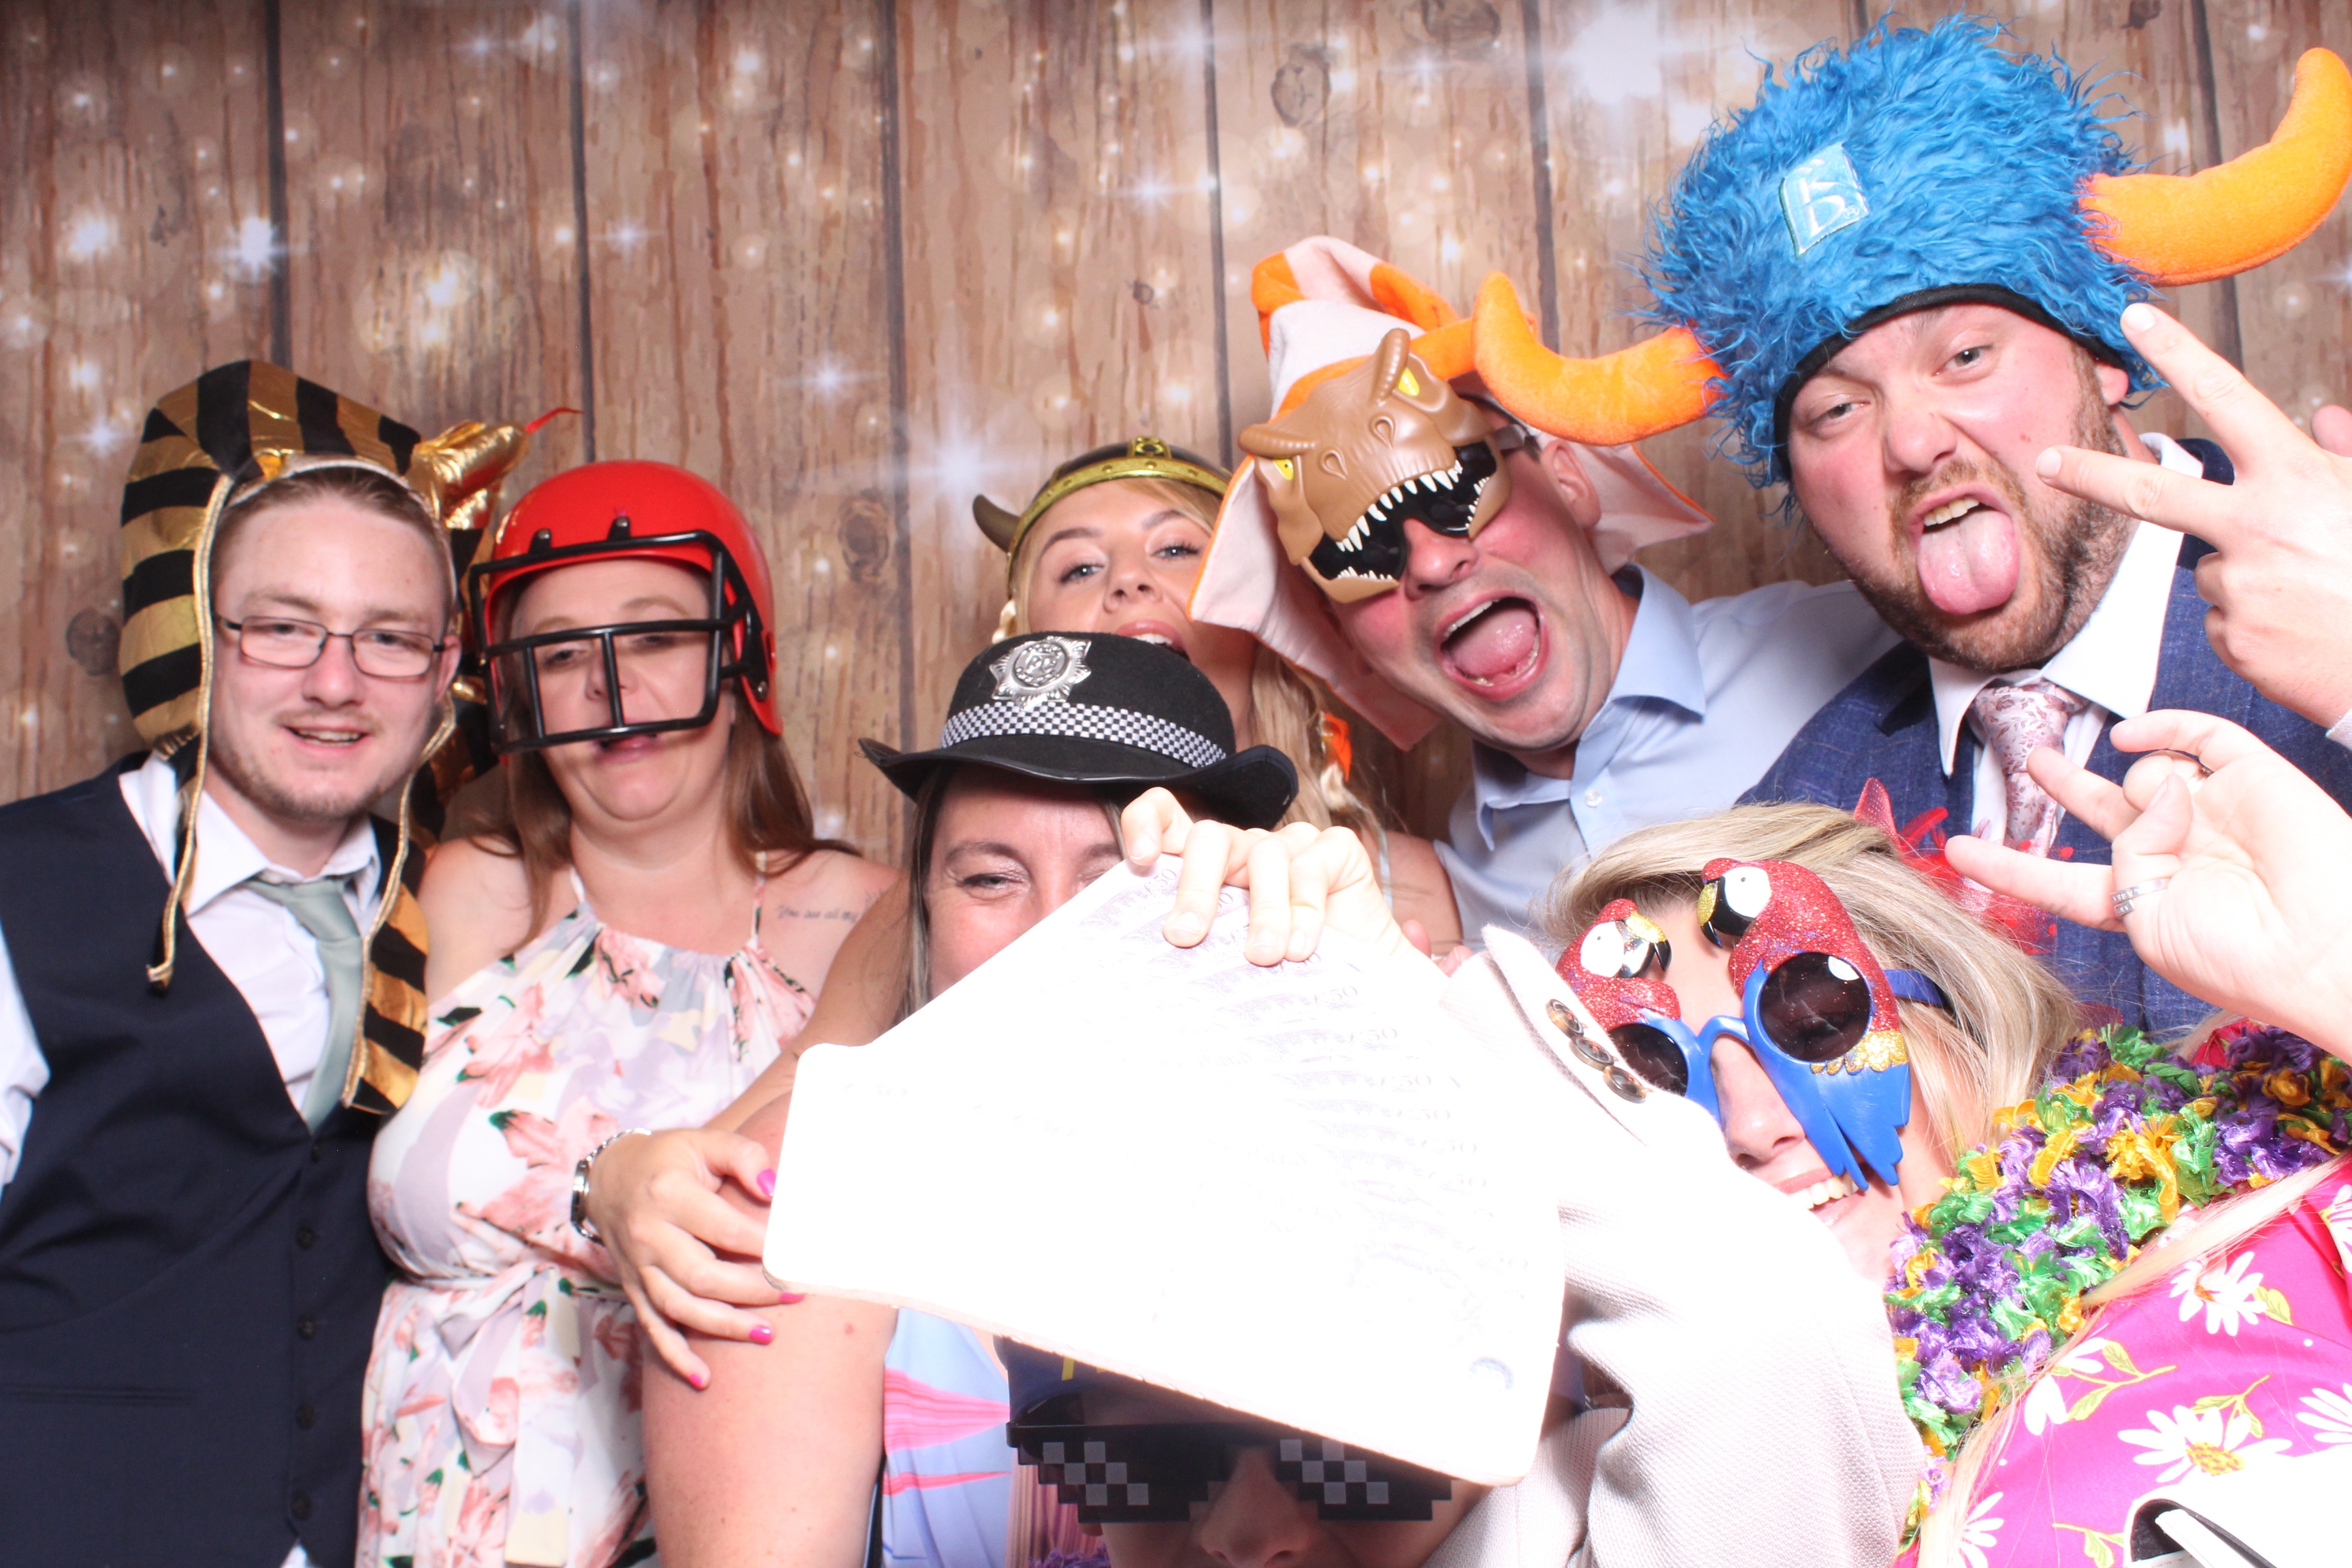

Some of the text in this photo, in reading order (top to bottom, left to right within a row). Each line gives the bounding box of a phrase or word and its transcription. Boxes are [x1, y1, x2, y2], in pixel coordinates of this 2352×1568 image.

[1143, 868, 1178, 896] £50
[1313, 985, 1358, 1005] £50
[1349, 1026, 1399, 1043] £50
[1380, 1074, 1432, 1088] £50
[1396, 1108, 1451, 1122] £50
